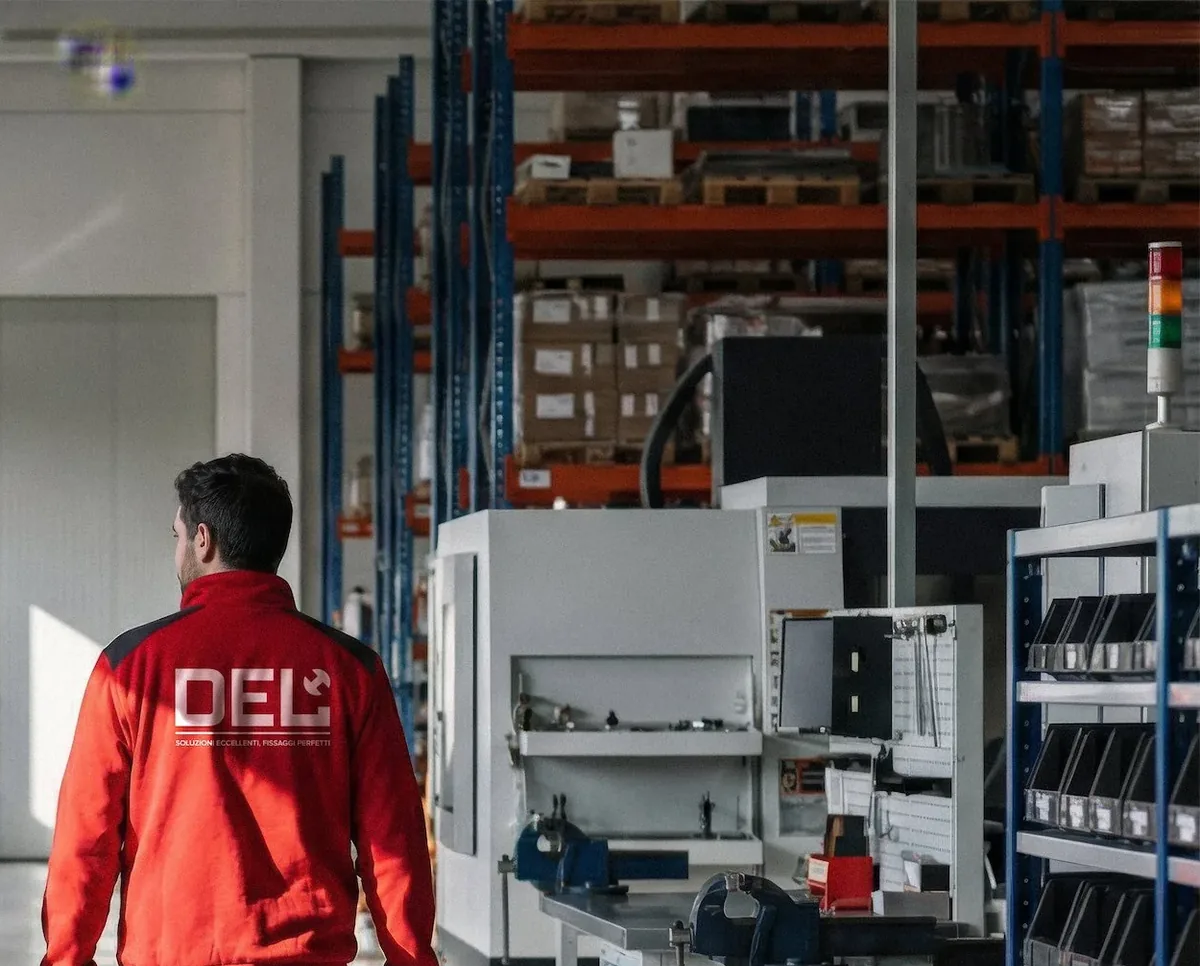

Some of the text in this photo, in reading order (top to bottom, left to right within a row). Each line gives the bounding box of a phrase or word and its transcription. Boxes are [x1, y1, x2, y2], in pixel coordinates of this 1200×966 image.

[175, 668, 331, 727] DEL
[175, 739, 215, 747] SOLUZIONI
[263, 739, 296, 747] FISSAGGI
[297, 739, 331, 747] PERFETTI
